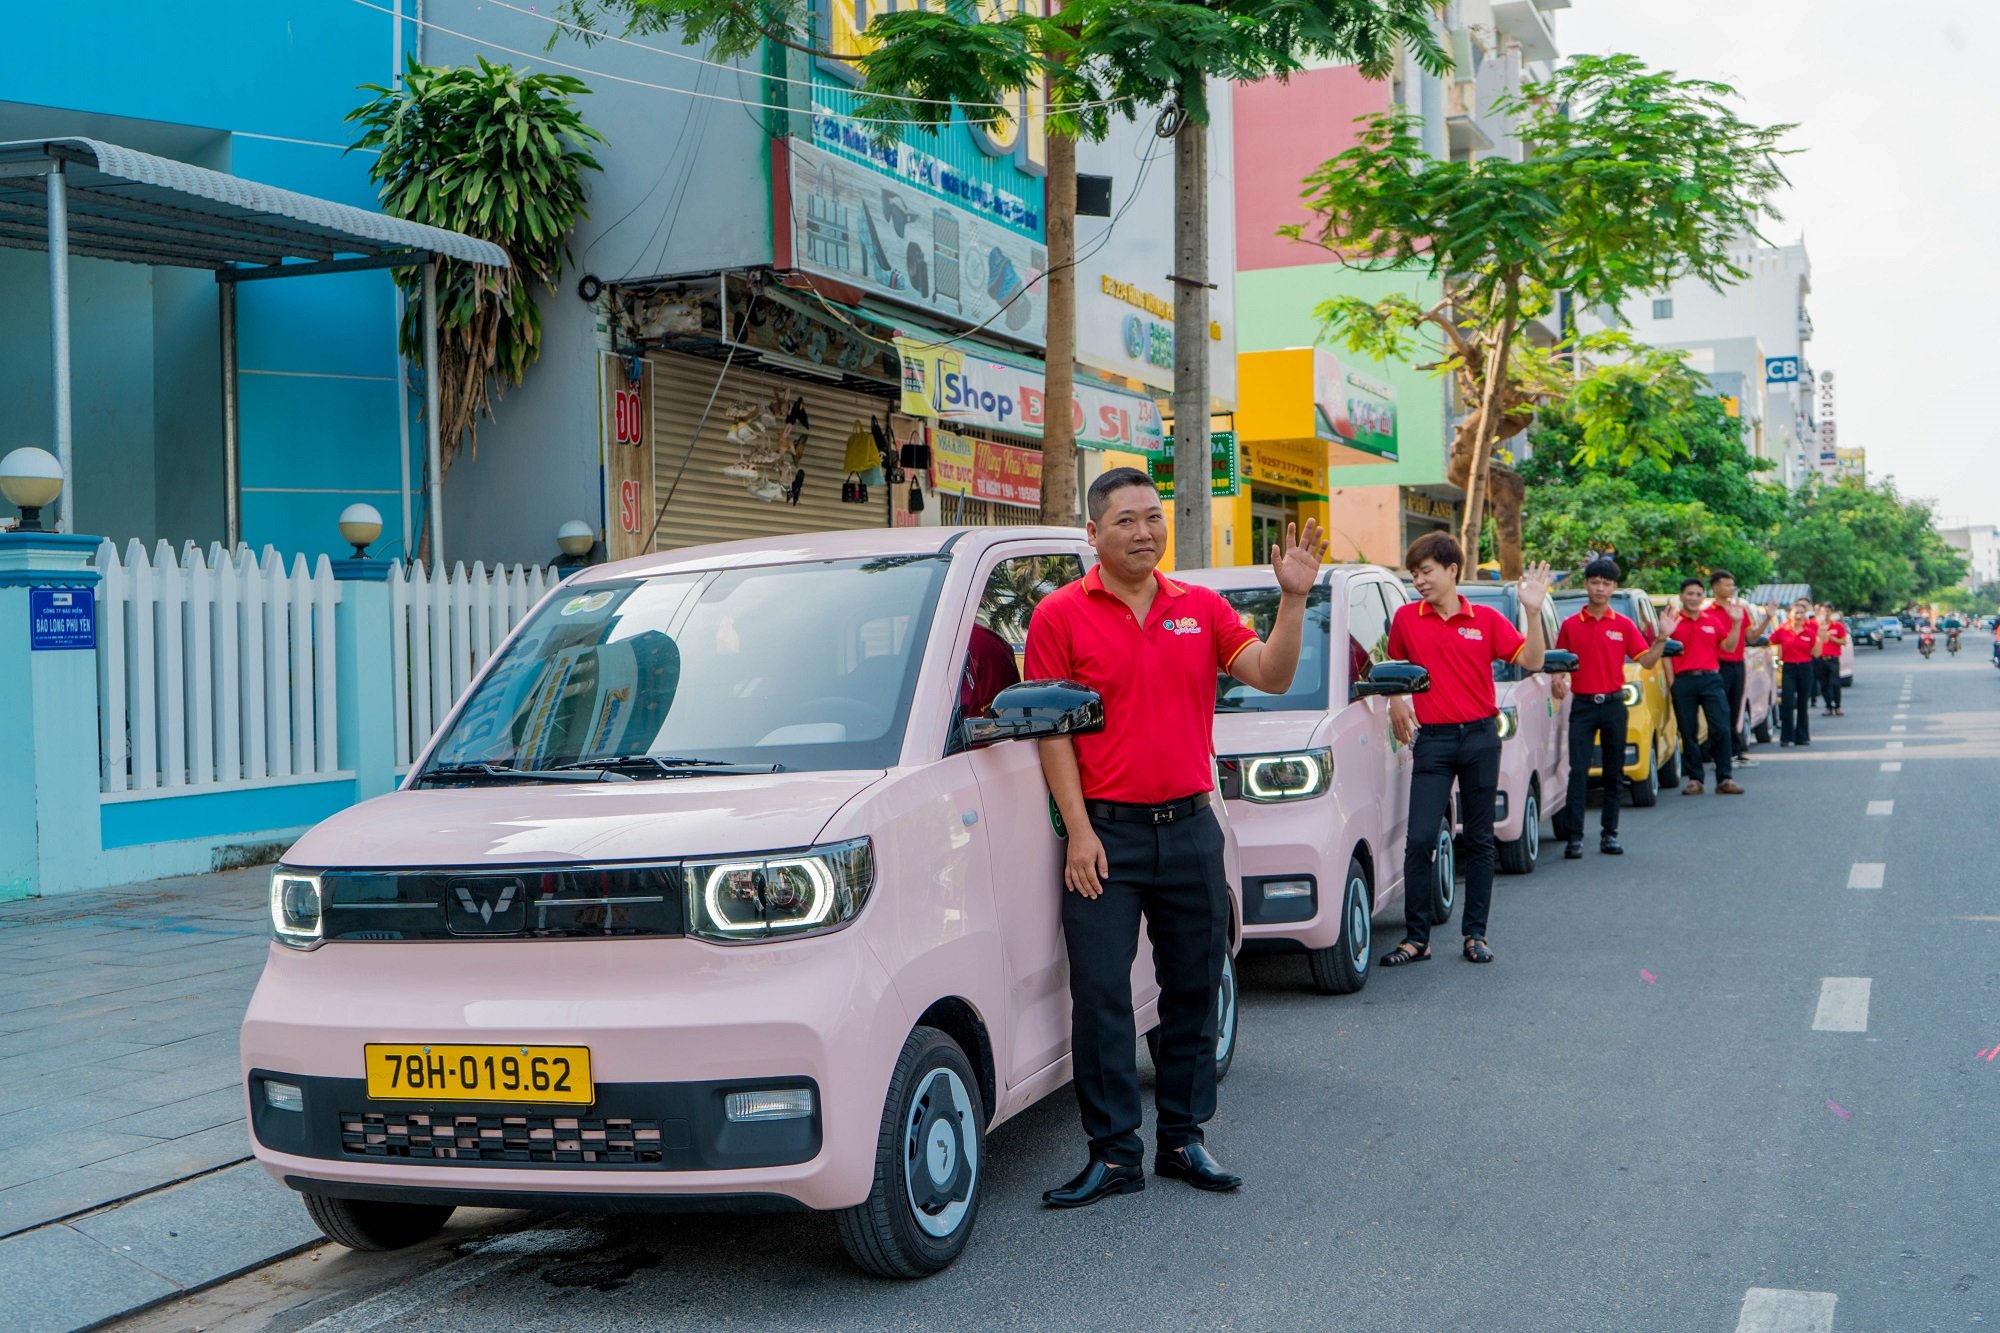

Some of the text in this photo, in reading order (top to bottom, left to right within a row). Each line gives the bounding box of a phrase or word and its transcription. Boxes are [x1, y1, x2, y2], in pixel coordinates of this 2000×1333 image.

[1768, 361, 1797, 379] CB
[614, 382, 643, 446] ĐỒ
[945, 373, 1013, 422] Shop
[1099, 405, 1131, 442] SI
[621, 479, 641, 533] SI
[36, 615, 91, 633] BẢO LONG PHÚ YÊN
[385, 1054, 571, 1092] 78H-019.62
